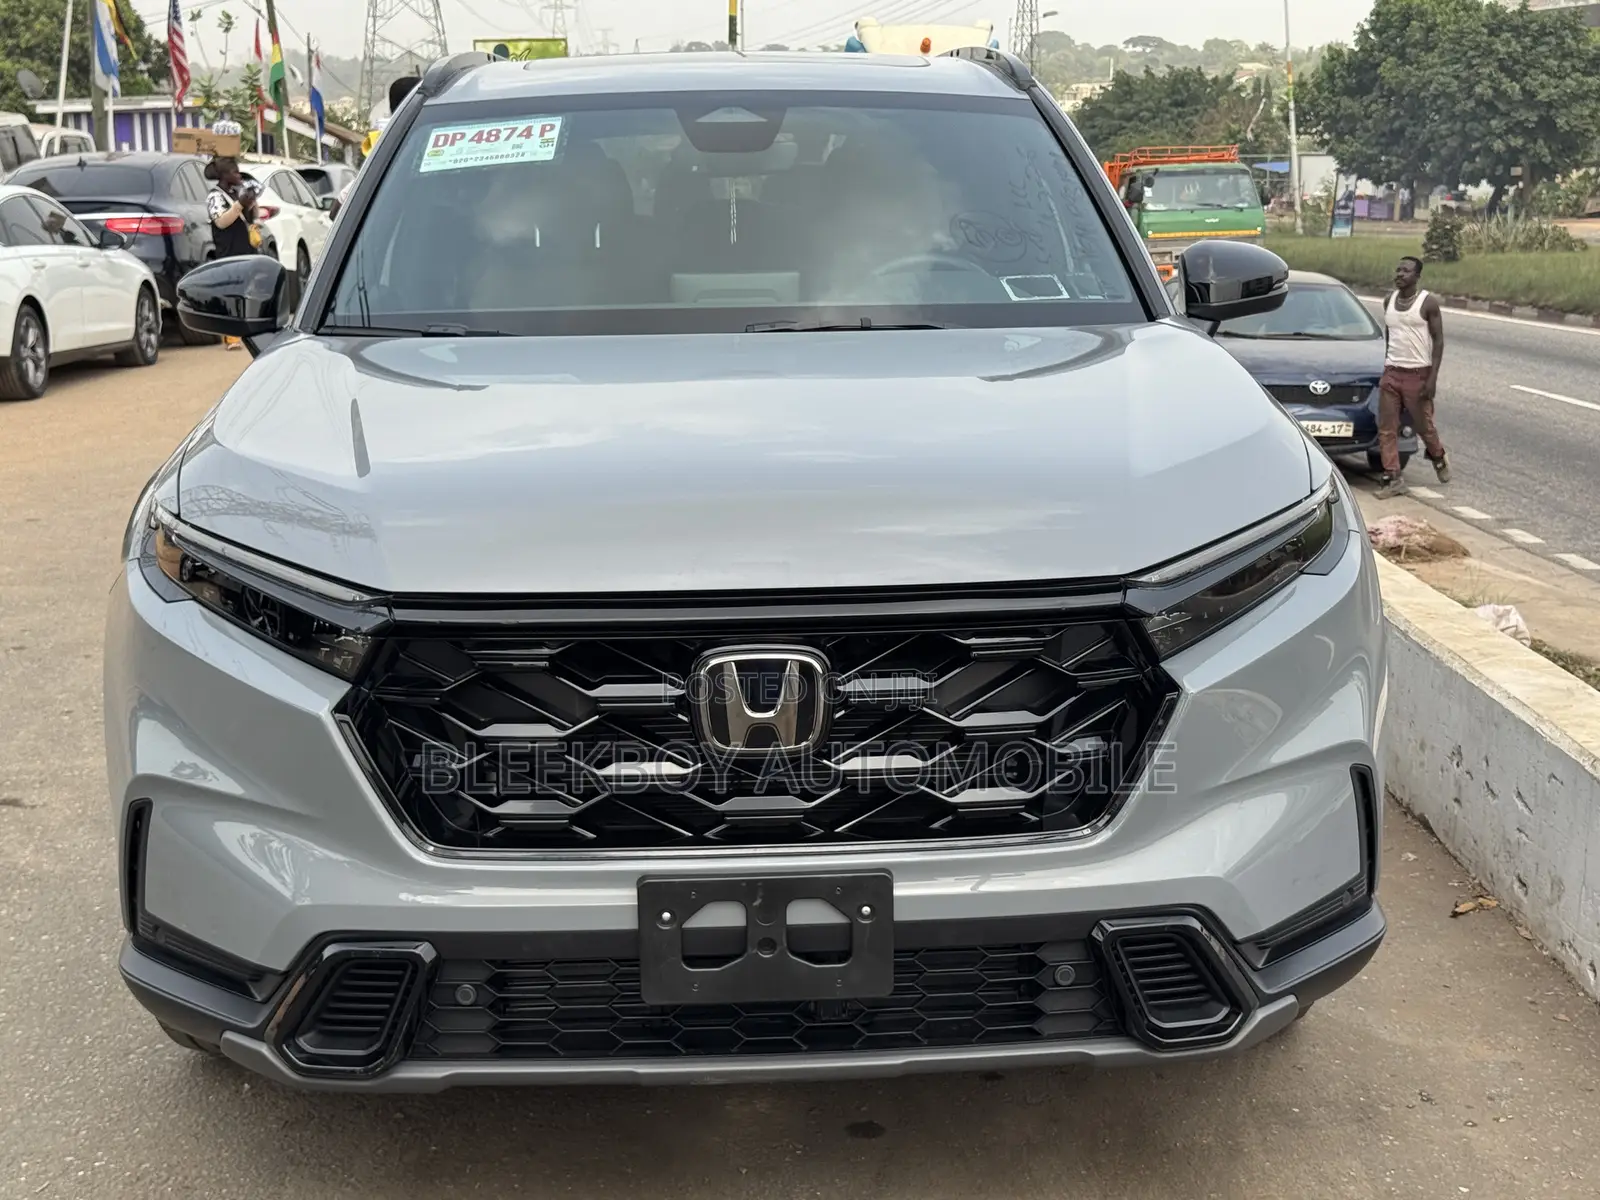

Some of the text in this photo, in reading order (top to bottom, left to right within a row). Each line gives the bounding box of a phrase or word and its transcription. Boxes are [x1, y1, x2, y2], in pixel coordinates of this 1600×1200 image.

[432, 123, 556, 148] DP 4874 P
